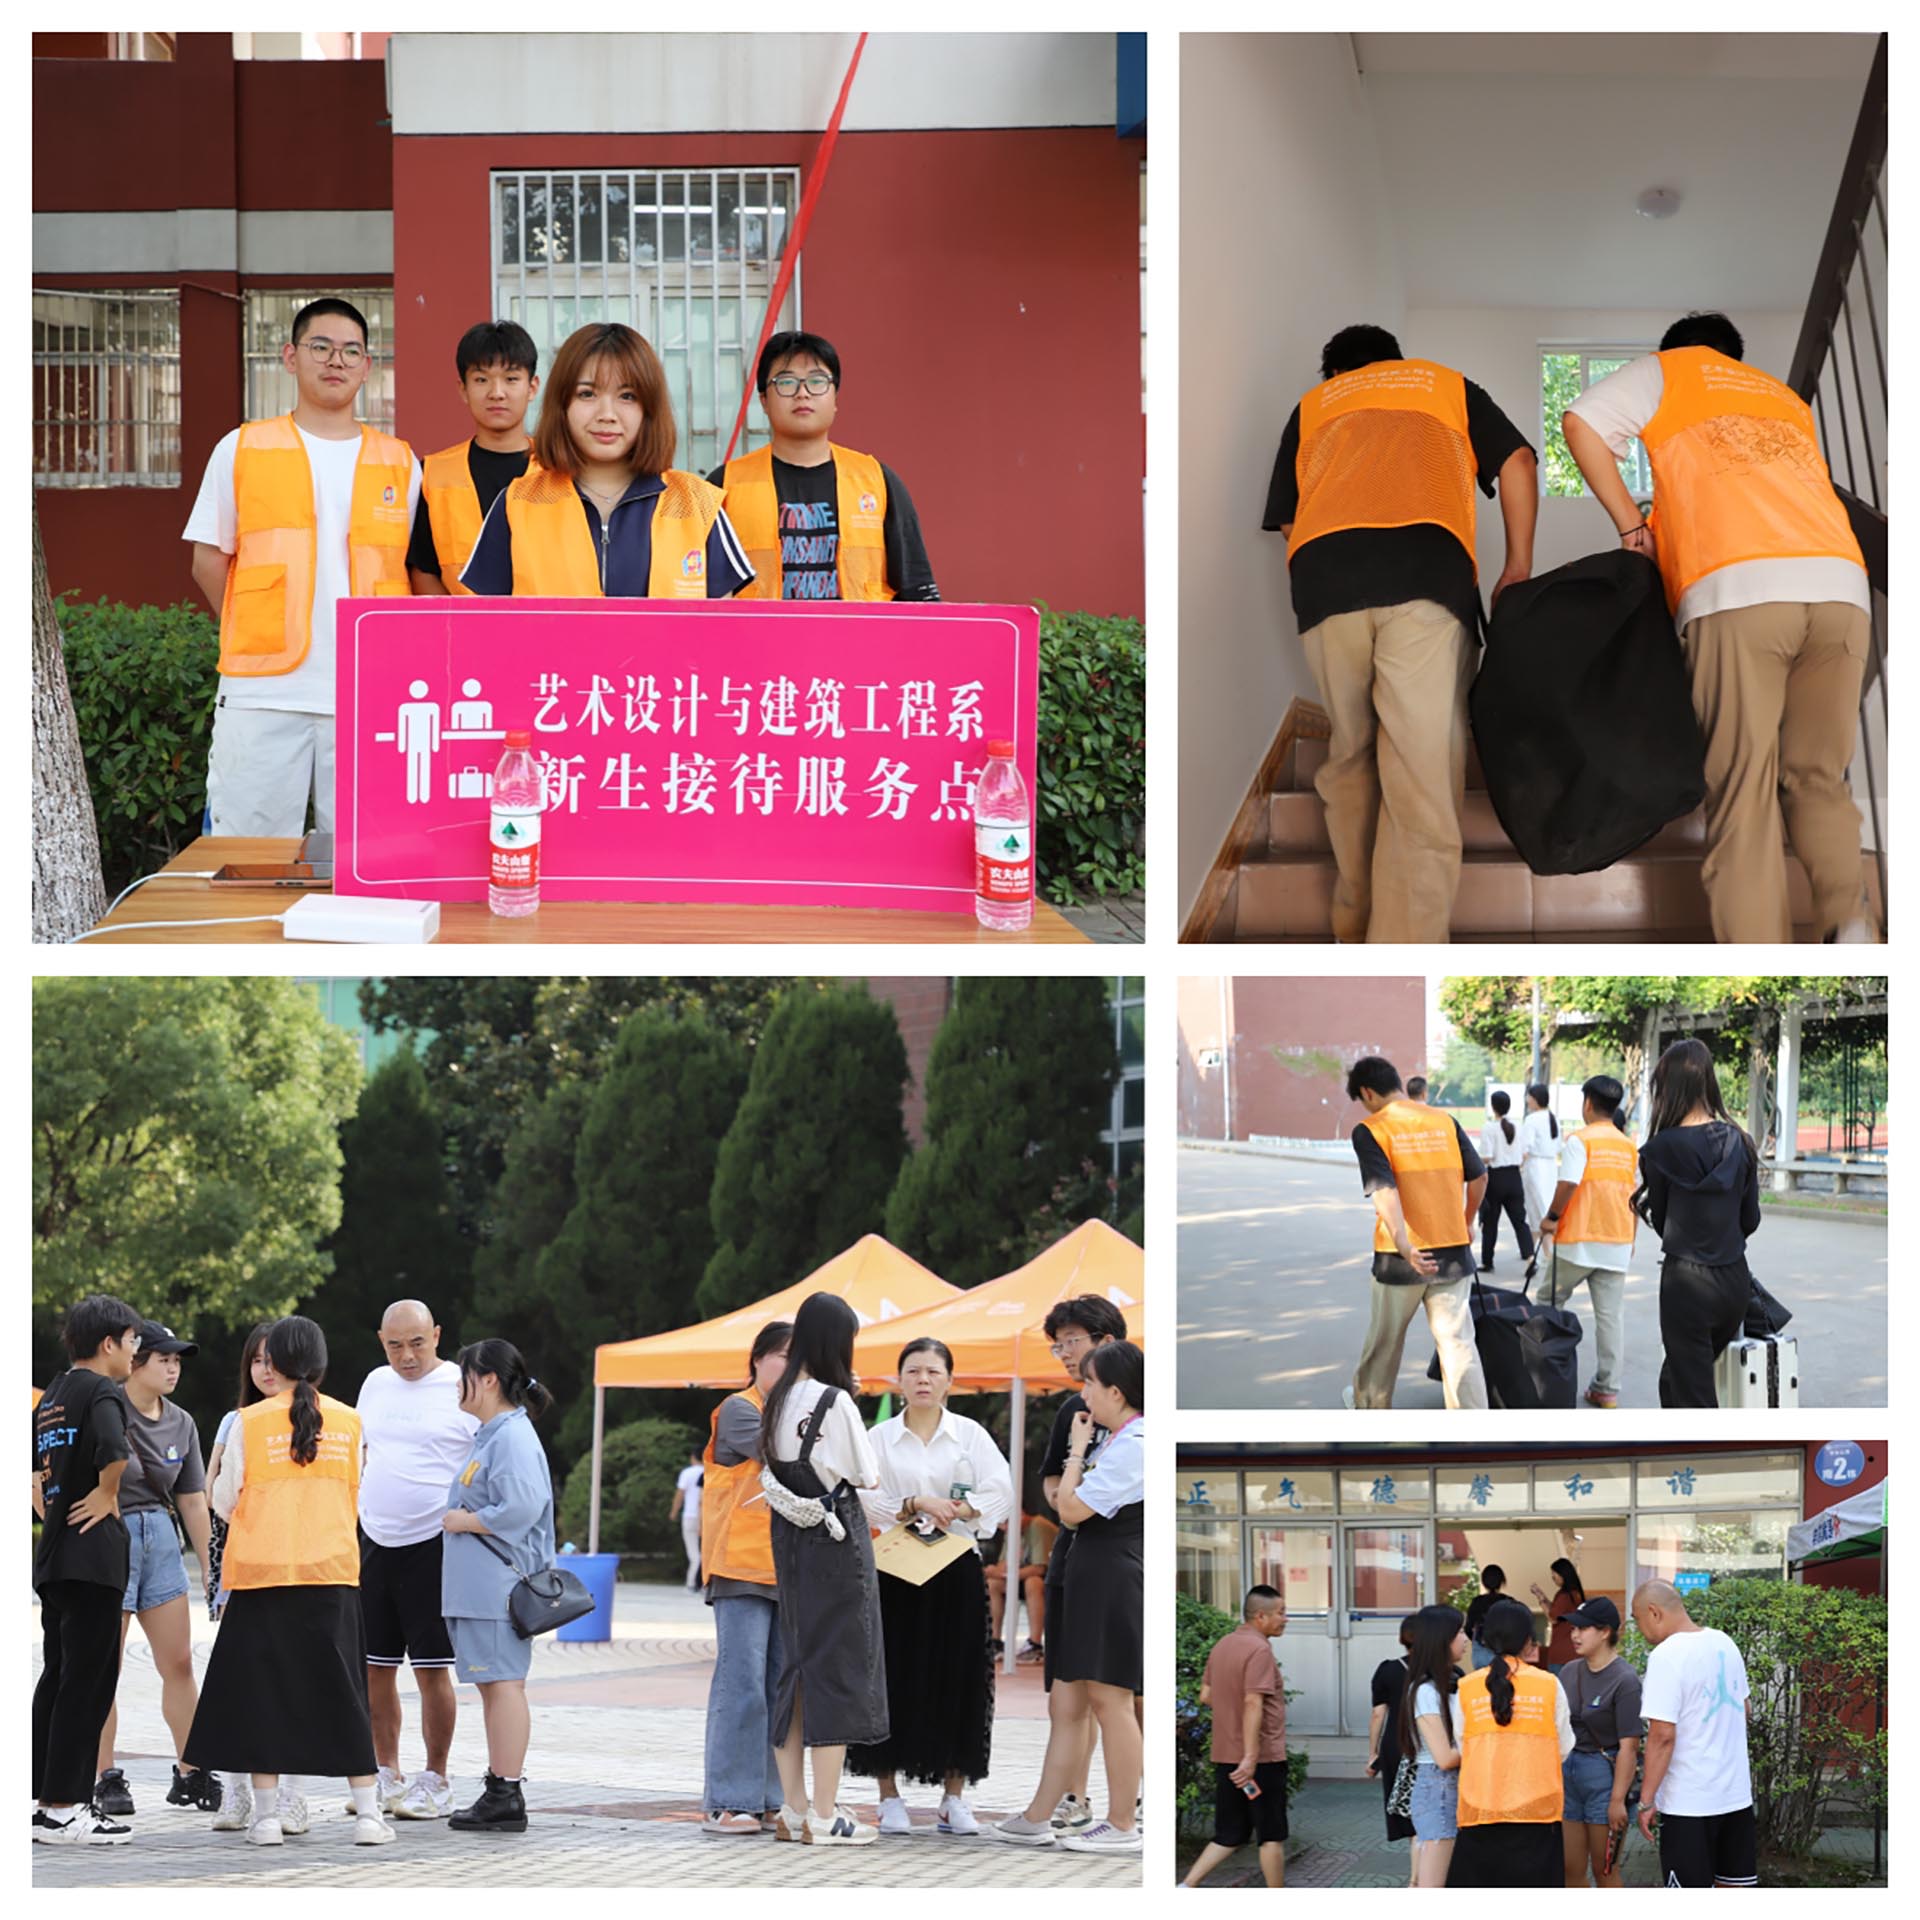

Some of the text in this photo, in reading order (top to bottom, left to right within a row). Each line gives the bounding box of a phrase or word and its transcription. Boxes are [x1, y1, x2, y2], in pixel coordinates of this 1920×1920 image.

[530, 673, 984, 742] 艺术设计与建筑工程系
[535, 750, 984, 821] 新生接待服务点
